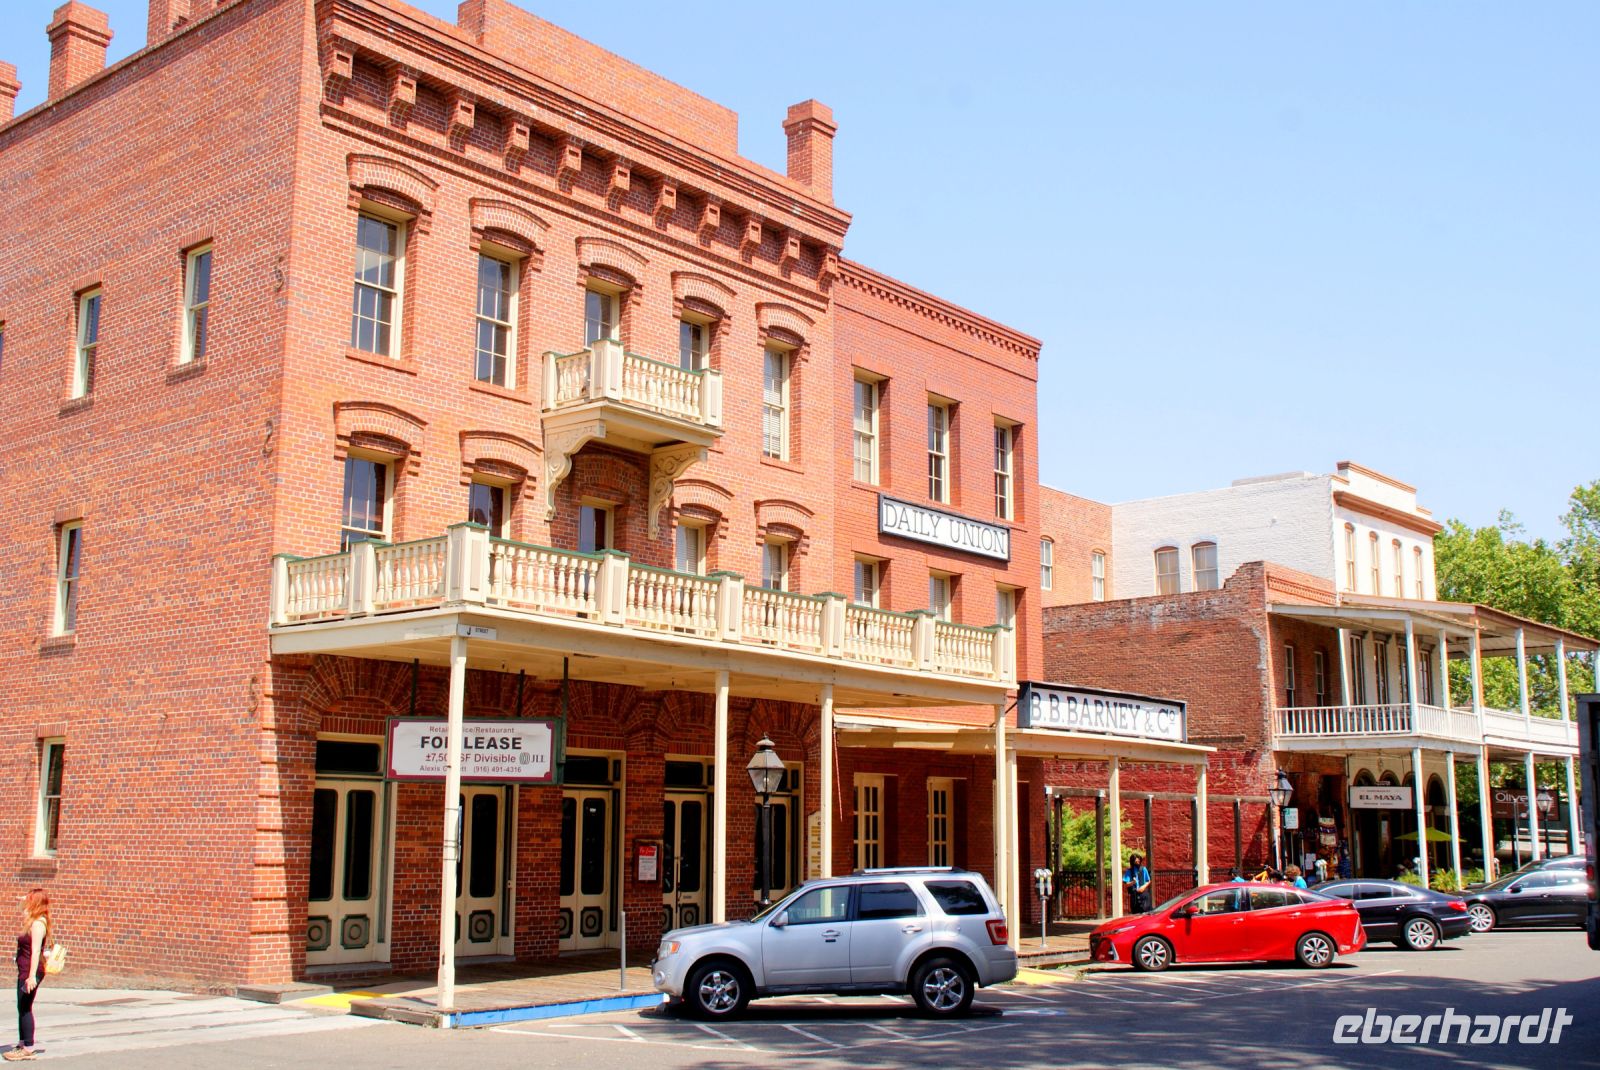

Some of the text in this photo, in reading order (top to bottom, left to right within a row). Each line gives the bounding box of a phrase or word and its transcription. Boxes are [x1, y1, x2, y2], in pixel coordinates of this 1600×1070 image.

[884, 503, 1006, 554] DAILY UNION
[466, 626, 472, 636] J
[1145, 710, 1154, 733] &
[464, 736, 523, 750] LEASE
[474, 753, 516, 763] Divisible
[473, 765, 490, 773] (916)
